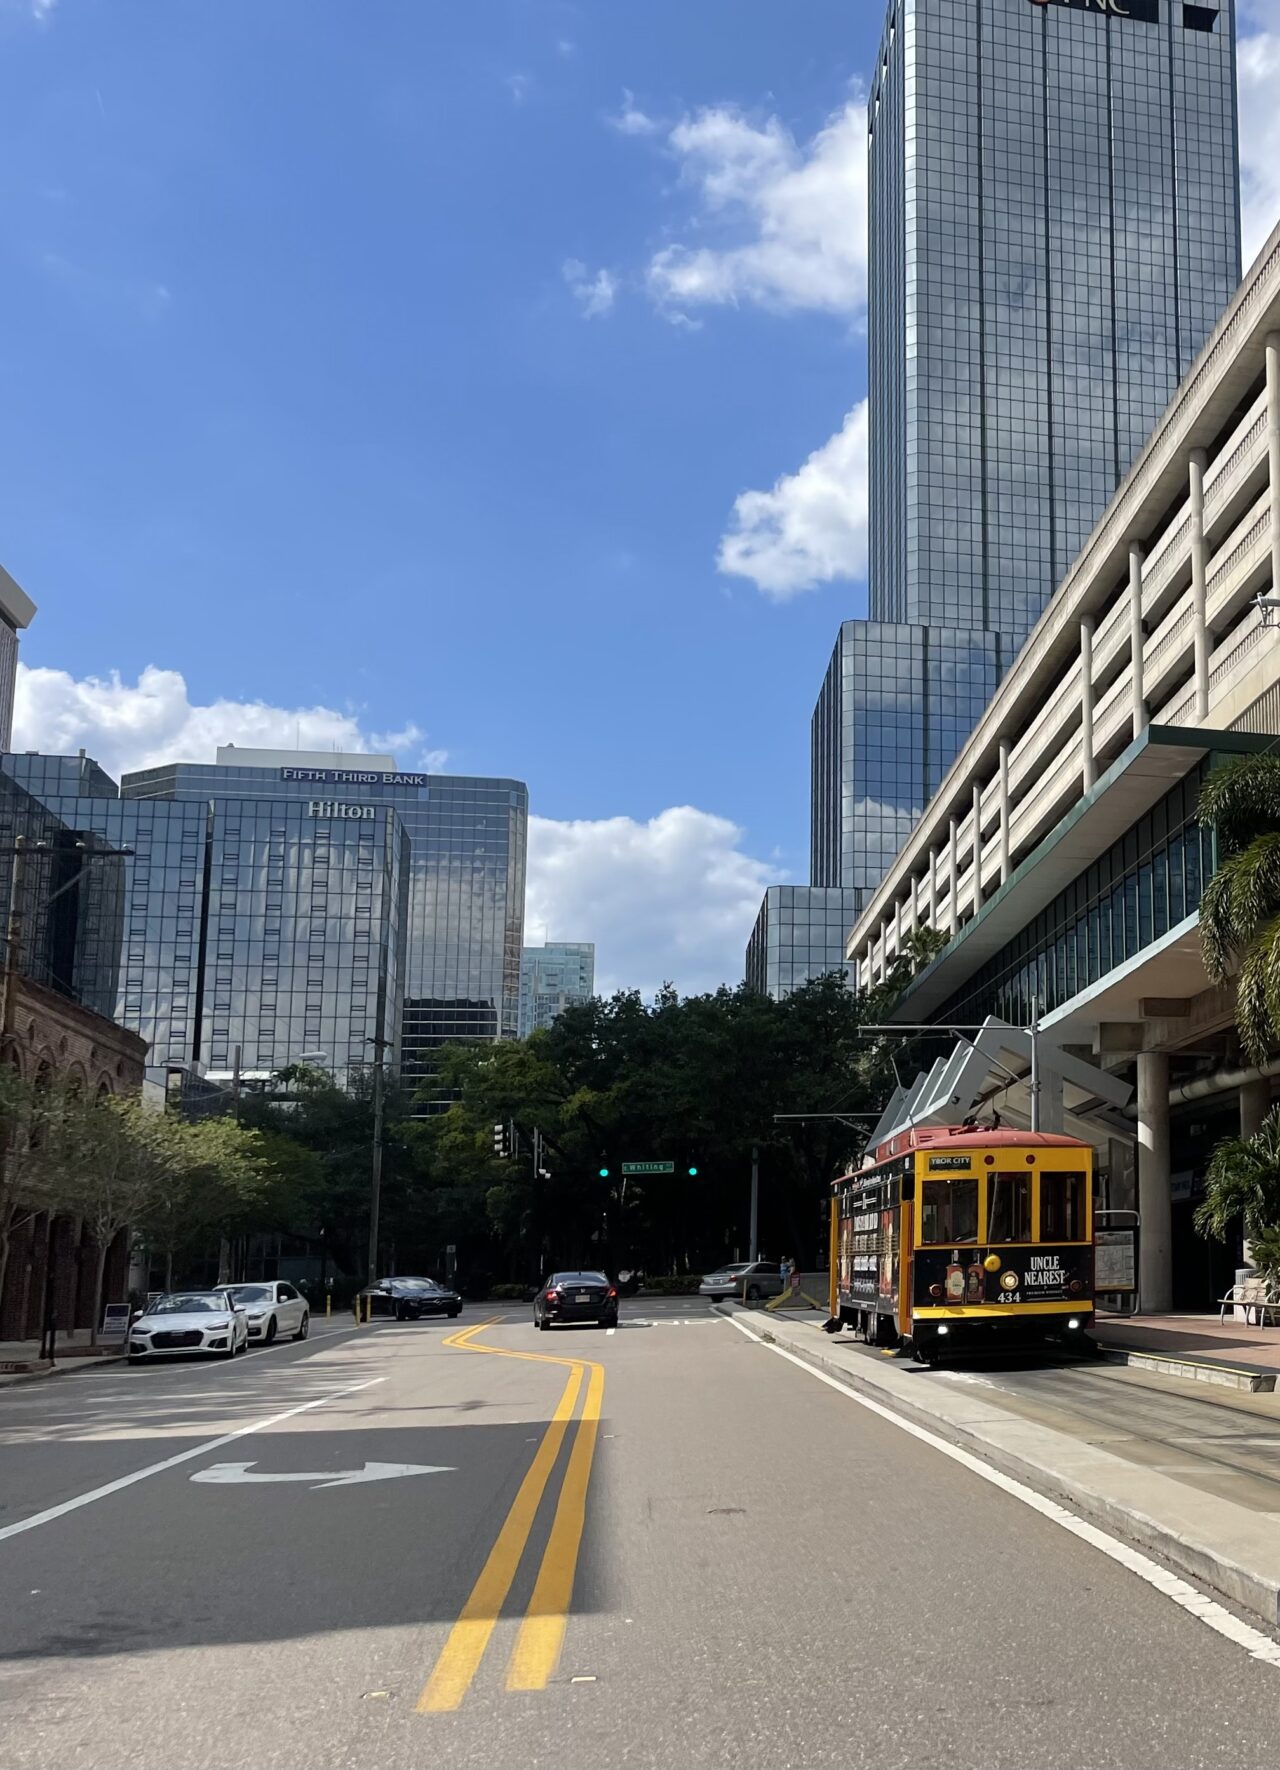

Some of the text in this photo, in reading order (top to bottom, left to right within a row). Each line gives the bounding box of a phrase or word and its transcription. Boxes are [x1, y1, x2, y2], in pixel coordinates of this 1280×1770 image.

[283, 768, 424, 785] FIFTH THIRD BANK
[308, 801, 376, 819] Hilton
[931, 1157, 952, 1165] YBOR
[1030, 1255, 1060, 1271] UNCLE
[1024, 1270, 1066, 1286] NEAREST
[997, 1292, 1021, 1303] 434
